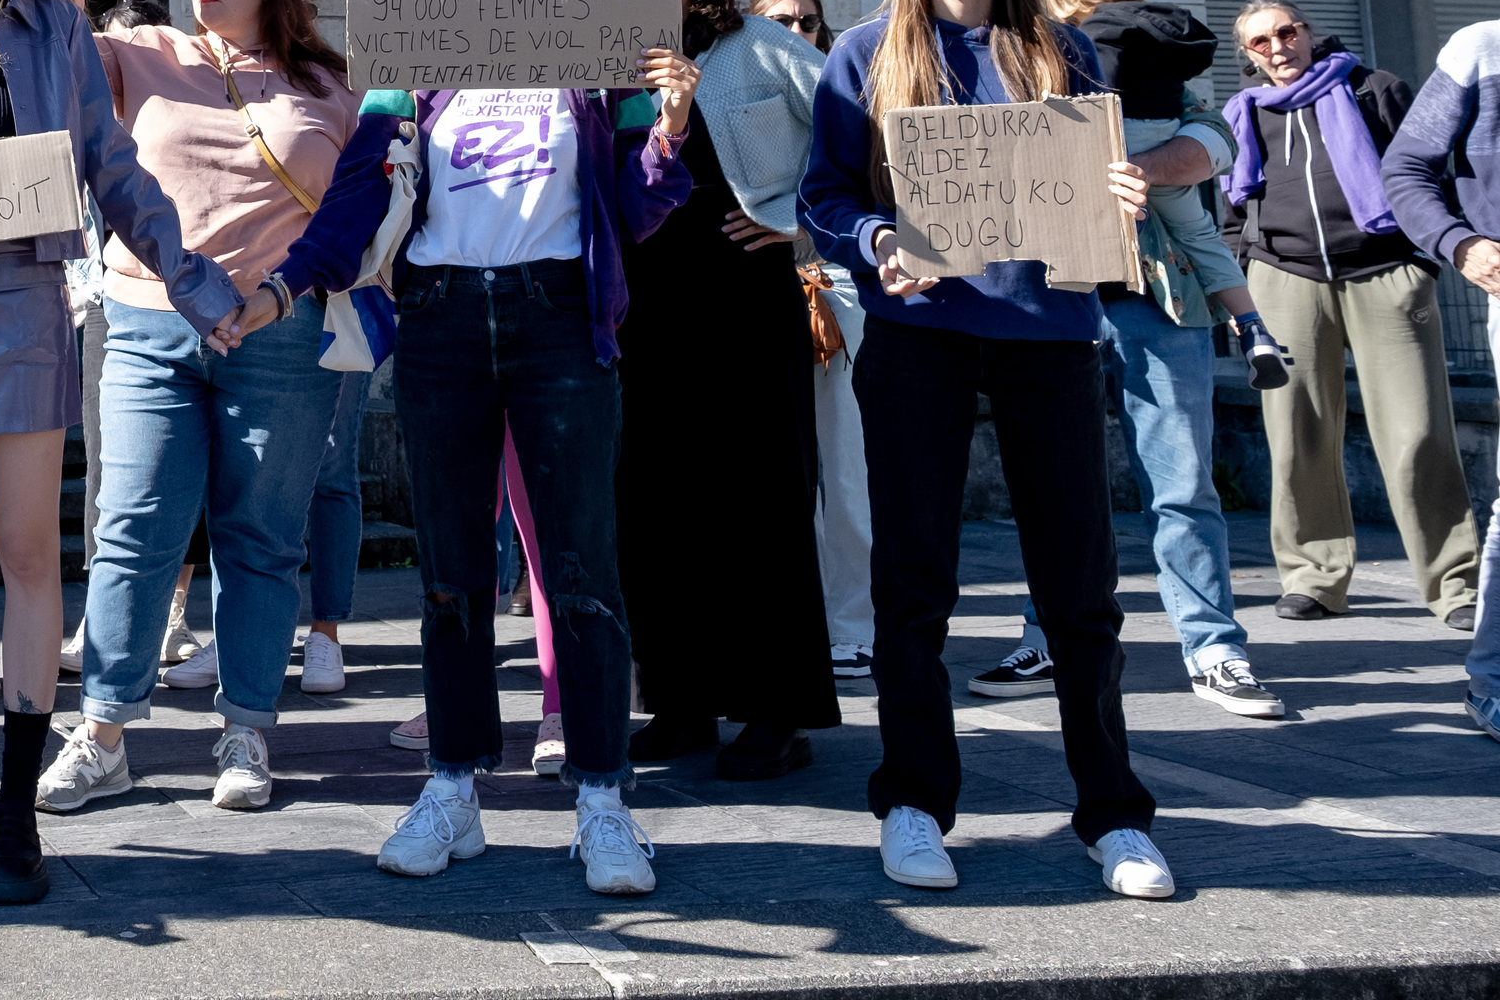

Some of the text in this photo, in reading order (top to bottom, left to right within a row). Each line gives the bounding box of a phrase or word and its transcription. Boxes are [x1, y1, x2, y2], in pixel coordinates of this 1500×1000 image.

[354, 23, 681, 55] VICTIMES DE VIOL PAR AN
[369, 58, 399, 85] (OU
[409, 60, 517, 85] TENTATIVE
[528, 63, 547, 84] DE
[603, 56, 628, 72] EN
[450, 114, 552, 170] EZ!
[899, 110, 1052, 143] BELDURRA
[926, 216, 1024, 252] DUGU
